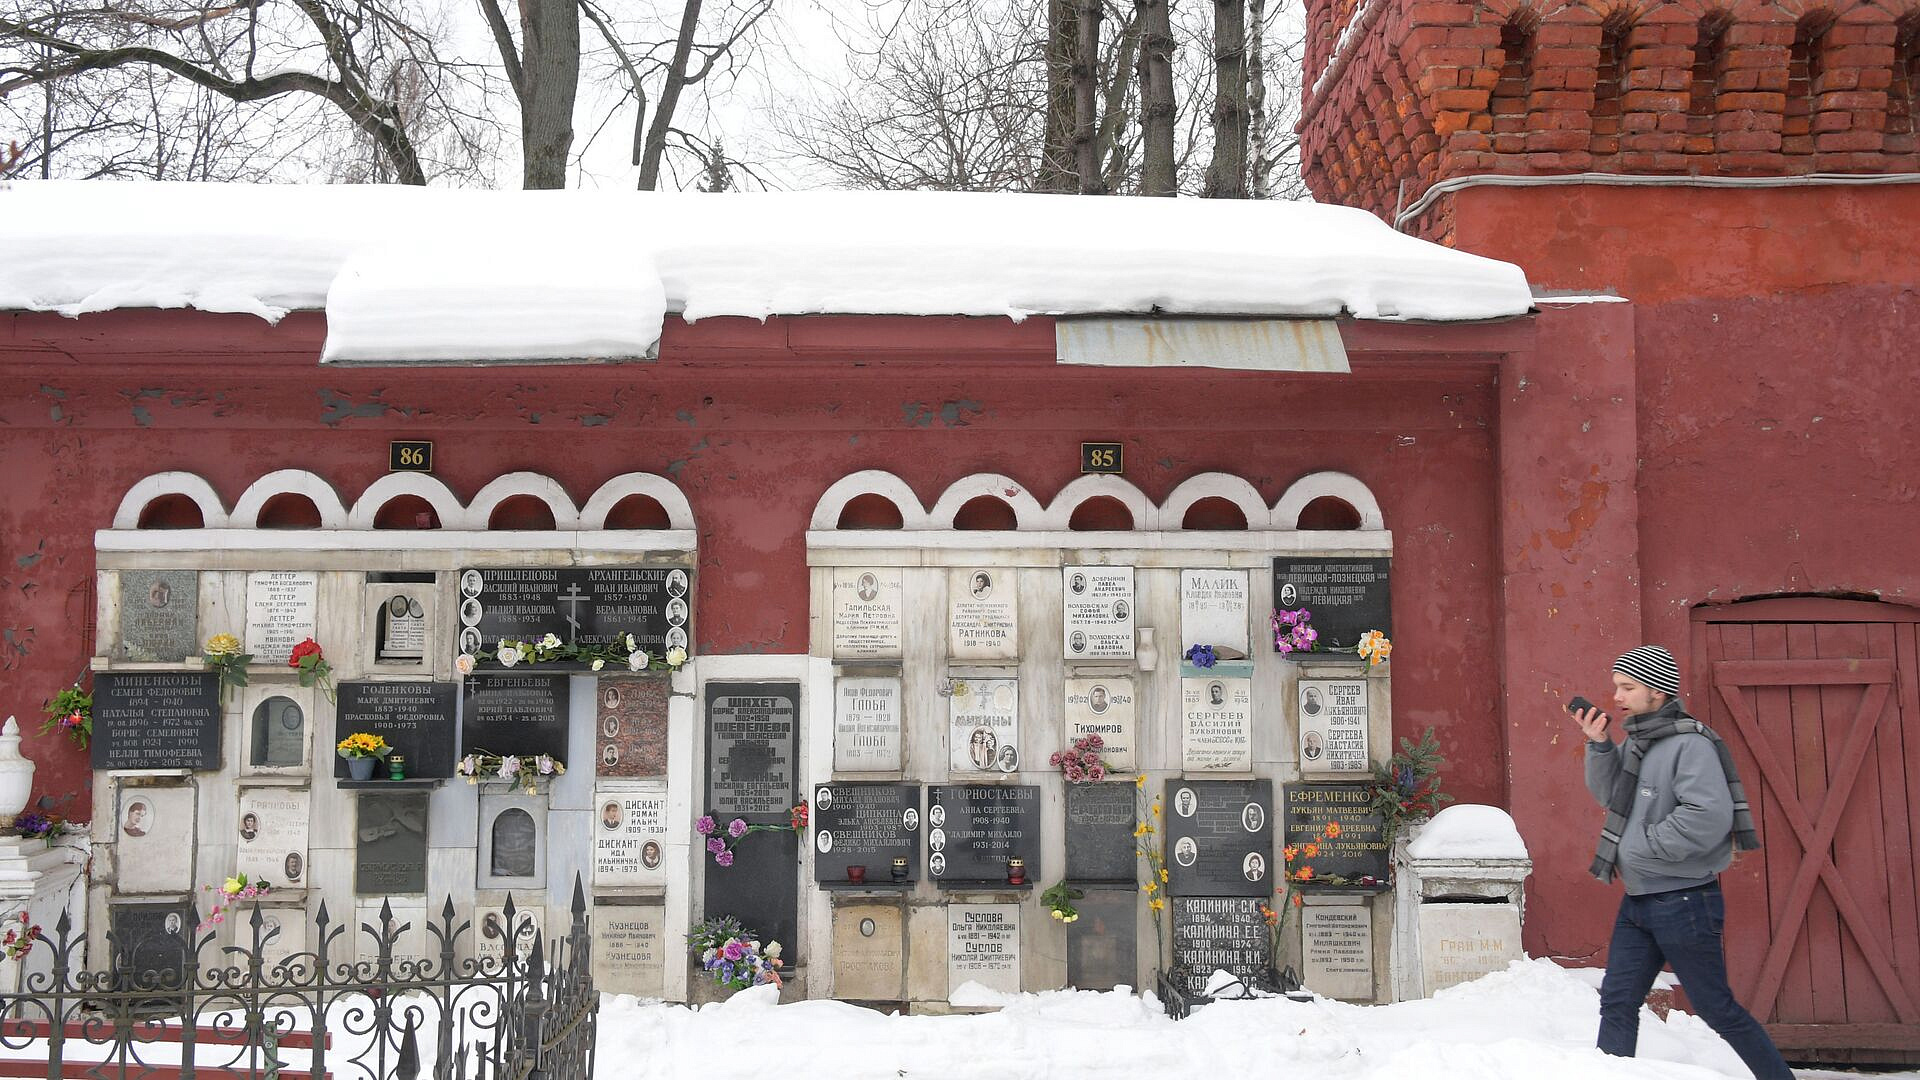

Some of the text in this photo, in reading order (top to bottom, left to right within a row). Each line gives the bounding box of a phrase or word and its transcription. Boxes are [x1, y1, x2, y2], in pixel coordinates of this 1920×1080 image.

[400, 448, 423, 464] 86
[1091, 450, 1114, 466] 85
[484, 571, 557, 581] ПРИШЛЕЦОВЫ
[588, 571, 665, 581] АРХАНГЕЛЬСКИЕ
[484, 584, 558, 593] ВАСИЛИЙ ИВАНОВИЧ
[594, 584, 659, 592] ИВАН ИВАНОВИЧ
[1312, 595, 1352, 605] ЛЕВИЦКАЯ
[486, 606, 555, 614] ЛИДИЯ ИВАНОВНА
[596, 606, 657, 614] ВЕРА ИВАНОВНА
[959, 629, 1006, 637] РАТНИКОВА
[114, 677, 201, 686] МИНЕНКОВЫ
[488, 679, 550, 687] ЕВГЕНЬЕВЫ
[147, 688, 202, 696] ФЕДОРОВИЧ
[362, 686, 431, 694] ГОЛЕНКОВЫ
[1329, 685, 1361, 695] СЕРГЕЕВ
[163, 698, 183, 706] 1940
[728, 698, 777, 707] ШАХЕТ
[1336, 696, 1356, 705] ИВАН
[151, 709, 210, 717] СТЕПАНОВНА
[345, 713, 445, 721] ПРАСКОВЬЯ ФЕДОРОВНА
[1074, 723, 1122, 733] ТИХОМИРОВ
[147, 729, 199, 737] СЕМЕНОВИЧ
[1328, 729, 1364, 740] СЕРГЕЕВА
[1325, 741, 1364, 750] АНАСТАСИЯ
[110, 749, 202, 758] НЕЛЛИ ТИМОФЕЕВНА
[1326, 751, 1366, 760] НИКИТИЧНА
[161, 758, 180, 766] 2015
[833, 788, 896, 796] СВЕШНИКОВ
[950, 790, 1033, 800] ГОРНОСТАЕВЫ
[1290, 792, 1370, 802] ЕФРЕМЕНКО
[625, 800, 664, 810] ДИСКАНТ
[857, 810, 902, 818] ЦИПКИНА
[960, 806, 1025, 814] АННА СЕРГЕЕВНА
[1326, 806, 1374, 814] МАТВЕЕВИЧ
[598, 840, 638, 849] ДИСКАНТ
[1186, 900, 1235, 913] КАЛИНИН
[965, 912, 1002, 922] СУСЛОВА
[609, 921, 649, 930] КУЗНЕЦОВ
[953, 923, 972, 931] ОЛЬГА
[1184, 925, 1239, 938] КАЛИНИНА
[966, 942, 1002, 952] СУСЛОВ
[1192, 940, 1251, 948] 1900 1974
[606, 951, 651, 960] КУЗНЕЦОВА
[1184, 950, 1240, 964] КАЛИНИНА
[1193, 965, 1251, 974] 1923 1994
